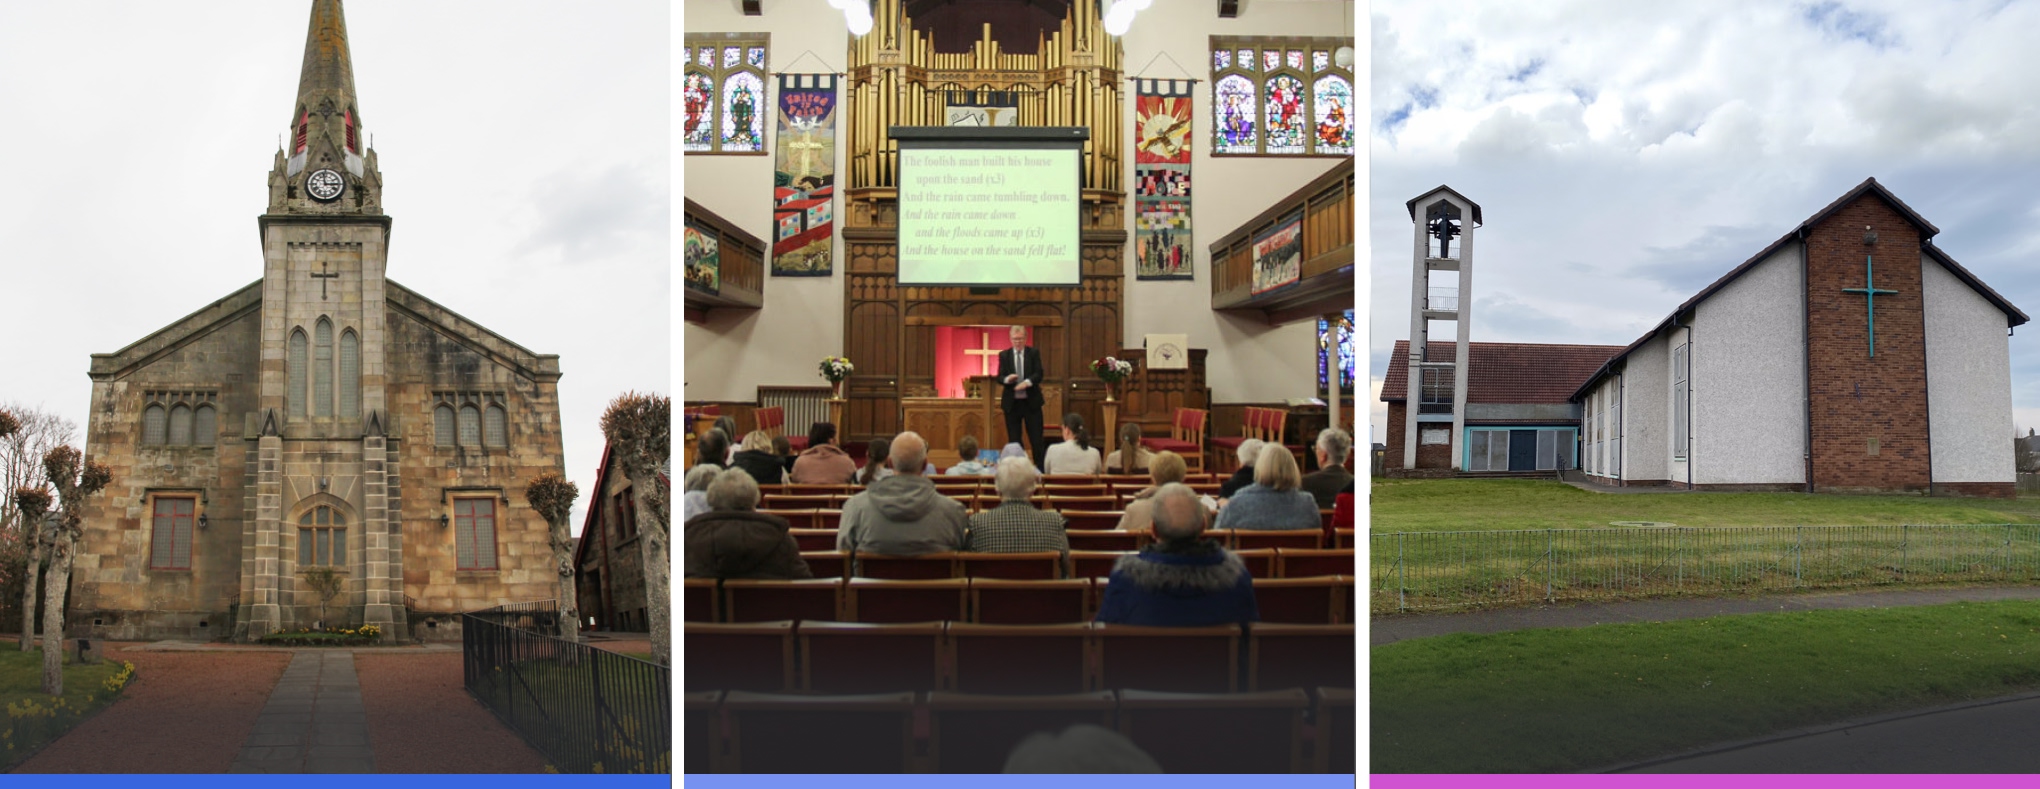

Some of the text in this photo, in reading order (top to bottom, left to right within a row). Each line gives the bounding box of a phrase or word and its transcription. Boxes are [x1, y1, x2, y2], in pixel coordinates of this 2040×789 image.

[904, 155, 1052, 167] The foolish man built his house
[916, 173, 1005, 187] upon the sand (x3)
[903, 191, 923, 202] And
[926, 191, 941, 202] the
[944, 191, 963, 202] rain
[966, 194, 991, 202] came
[994, 191, 1038, 204] tumbling
[902, 209, 1016, 220] And the rain came down
[915, 227, 1045, 241] and the floods came up (x3)
[902, 245, 1067, 258] And the house on the sand fell flat!
